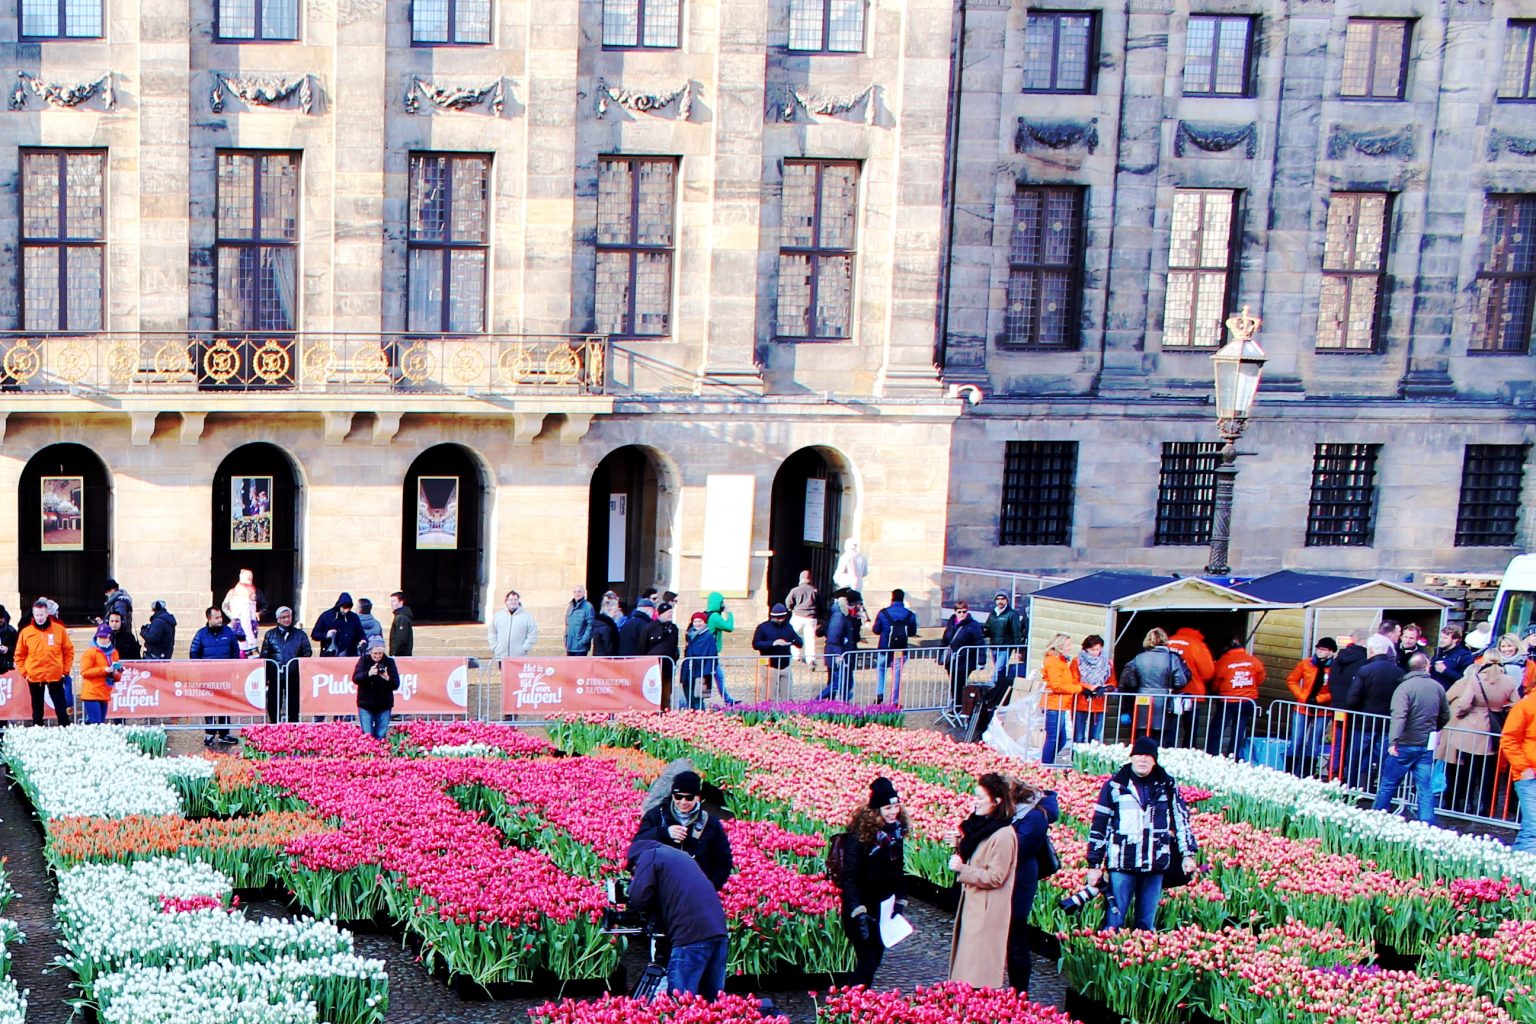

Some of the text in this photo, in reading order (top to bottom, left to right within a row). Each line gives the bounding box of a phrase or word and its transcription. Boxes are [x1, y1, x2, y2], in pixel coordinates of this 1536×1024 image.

[523, 663, 544, 672] Het is
[312, 673, 356, 697] Pluk
[110, 689, 159, 712] Tulpen!
[512, 687, 562, 709] Tulpen!
